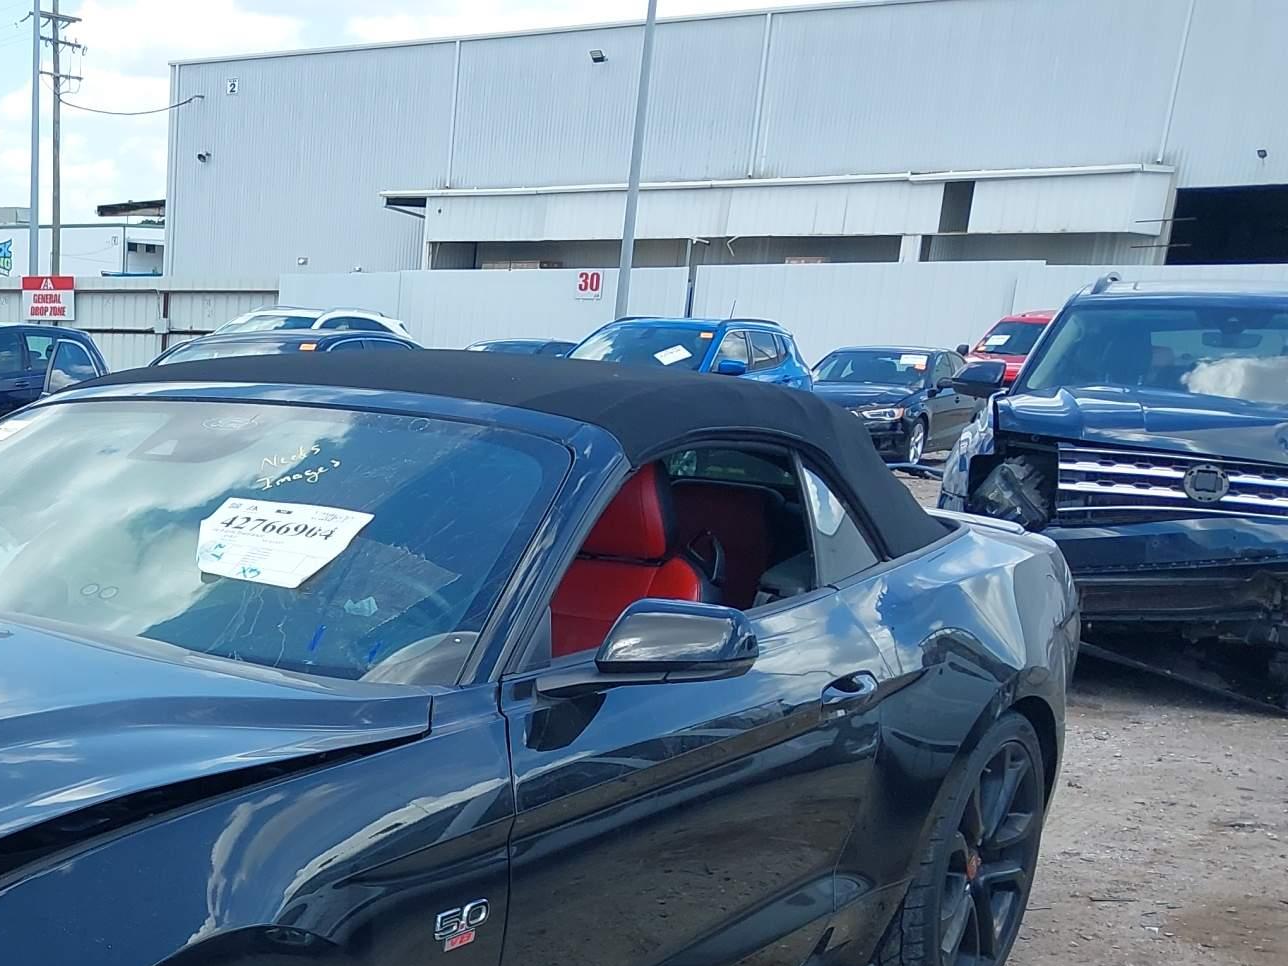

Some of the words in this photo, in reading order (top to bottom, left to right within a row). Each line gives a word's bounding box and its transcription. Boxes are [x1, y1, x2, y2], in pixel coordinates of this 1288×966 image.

[229, 82, 236, 93] 2
[578, 271, 601, 292] 30
[32, 294, 61, 304] GENERAL
[30, 306, 49, 316] DROP
[50, 306, 66, 316] ZONE
[434, 897, 491, 941] 5.0
